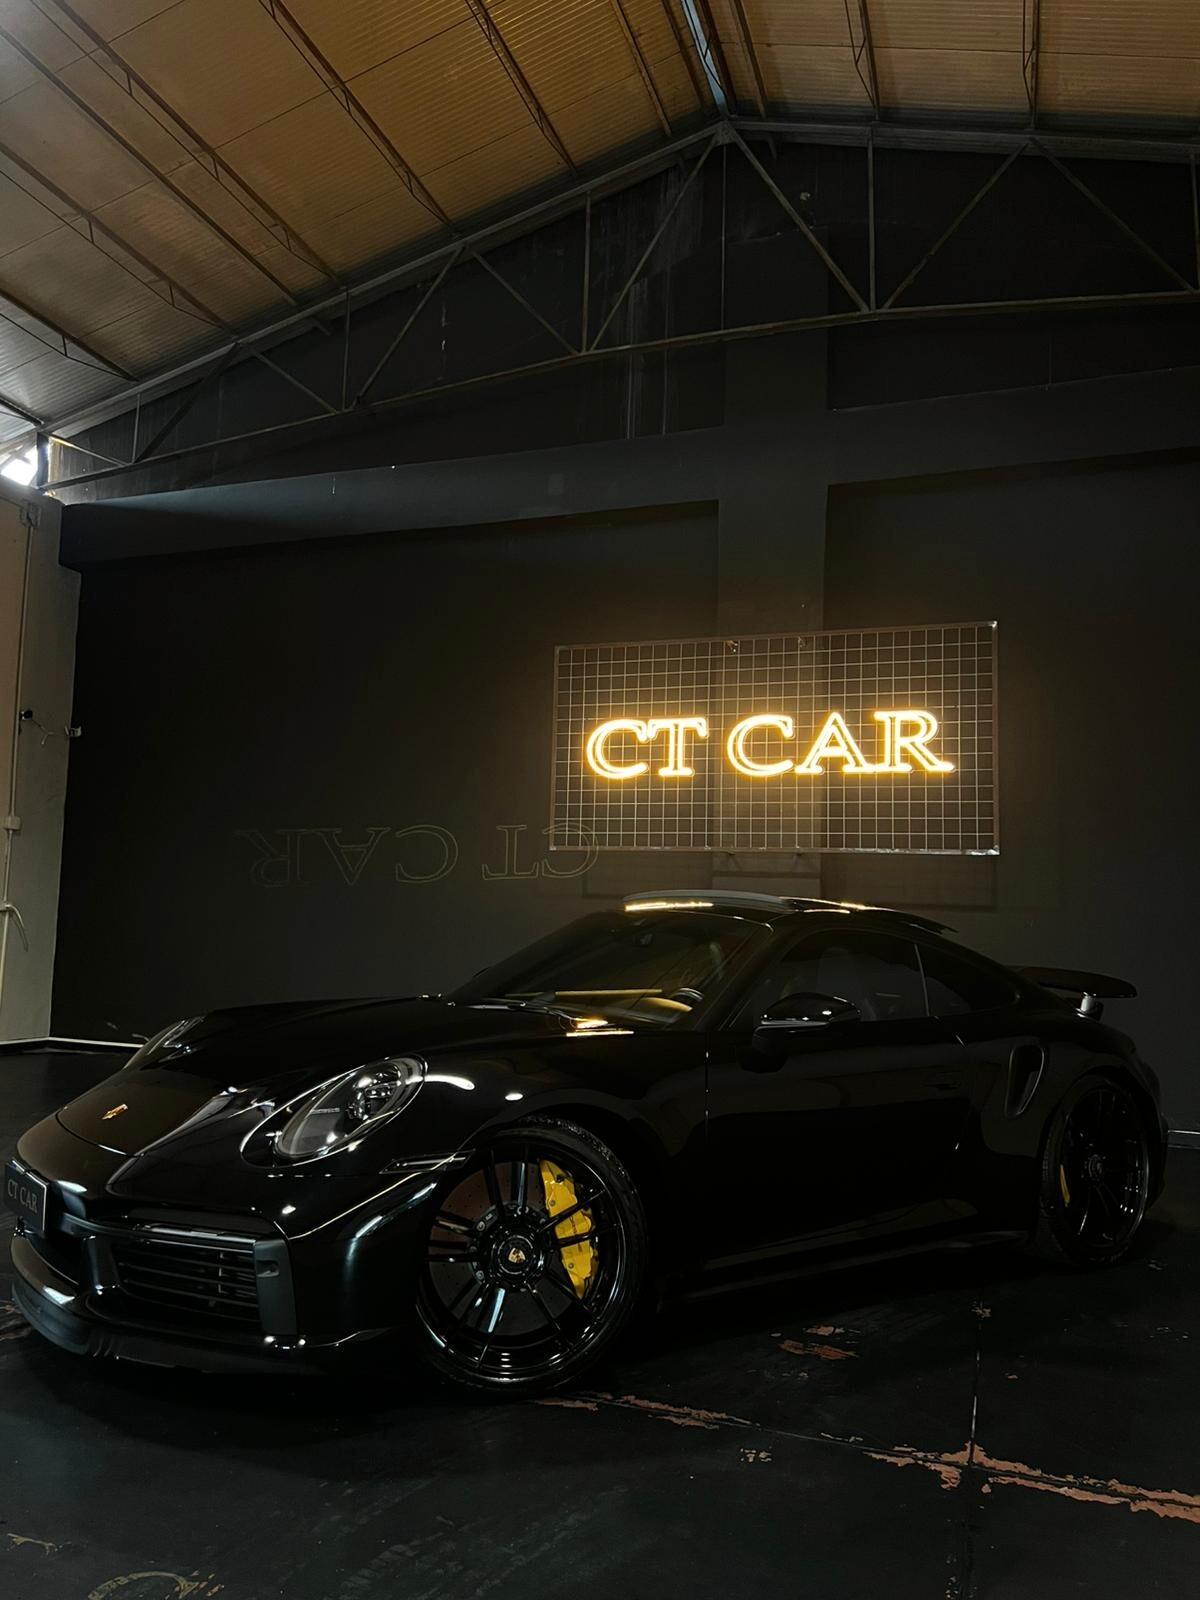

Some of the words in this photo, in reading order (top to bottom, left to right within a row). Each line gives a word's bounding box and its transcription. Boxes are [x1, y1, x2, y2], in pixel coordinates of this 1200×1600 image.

[585, 716, 709, 780] CT
[725, 709, 956, 777] CAR
[7, 1179, 18, 1199] CT
[20, 1187, 38, 1215] CAR
